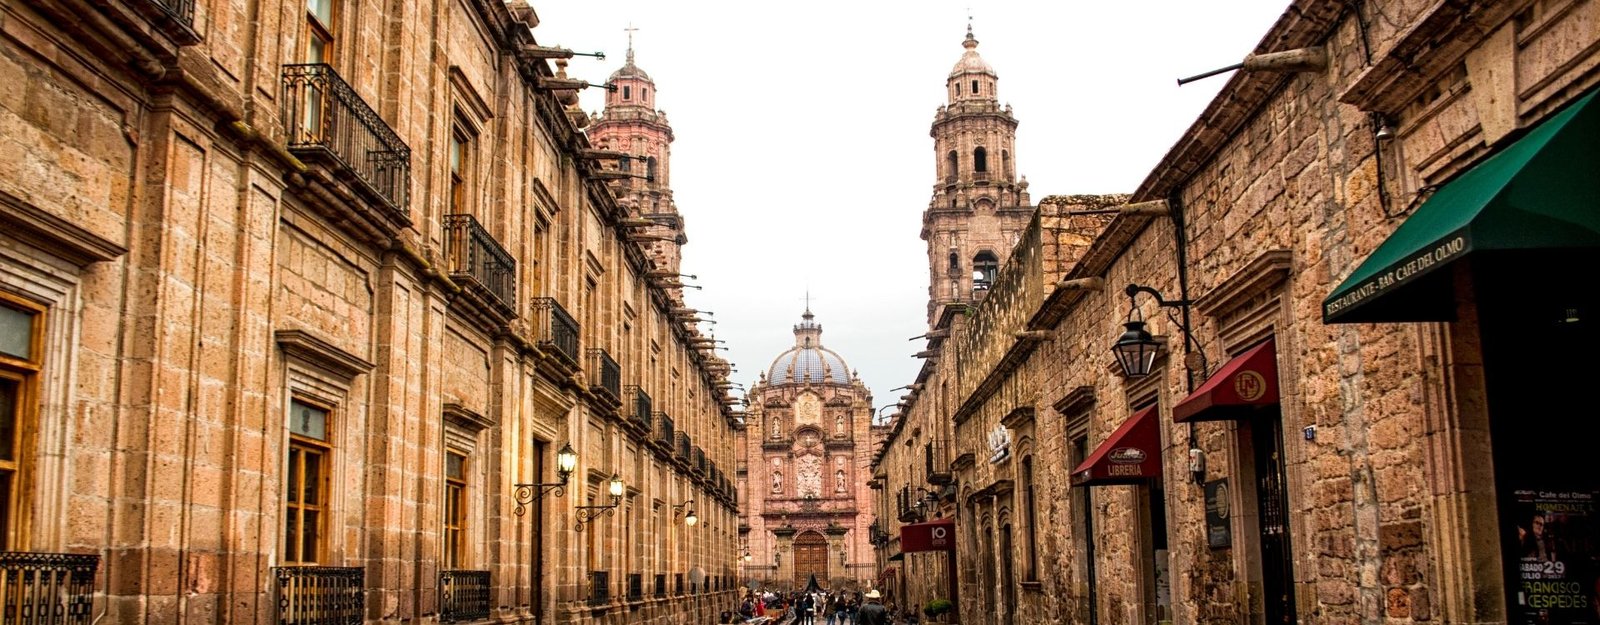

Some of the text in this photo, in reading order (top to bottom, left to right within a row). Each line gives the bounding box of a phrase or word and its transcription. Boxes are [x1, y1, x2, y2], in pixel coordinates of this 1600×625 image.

[1396, 260, 1417, 280] CAFE
[1418, 254, 1435, 270] DEL
[1435, 237, 1464, 261] OLMO
[1107, 464, 1142, 476] LIBRERIA
[1539, 491, 1557, 499] Cafe
[1520, 561, 1565, 574] ABADO 29
[1528, 595, 1588, 608] CESPEDES
